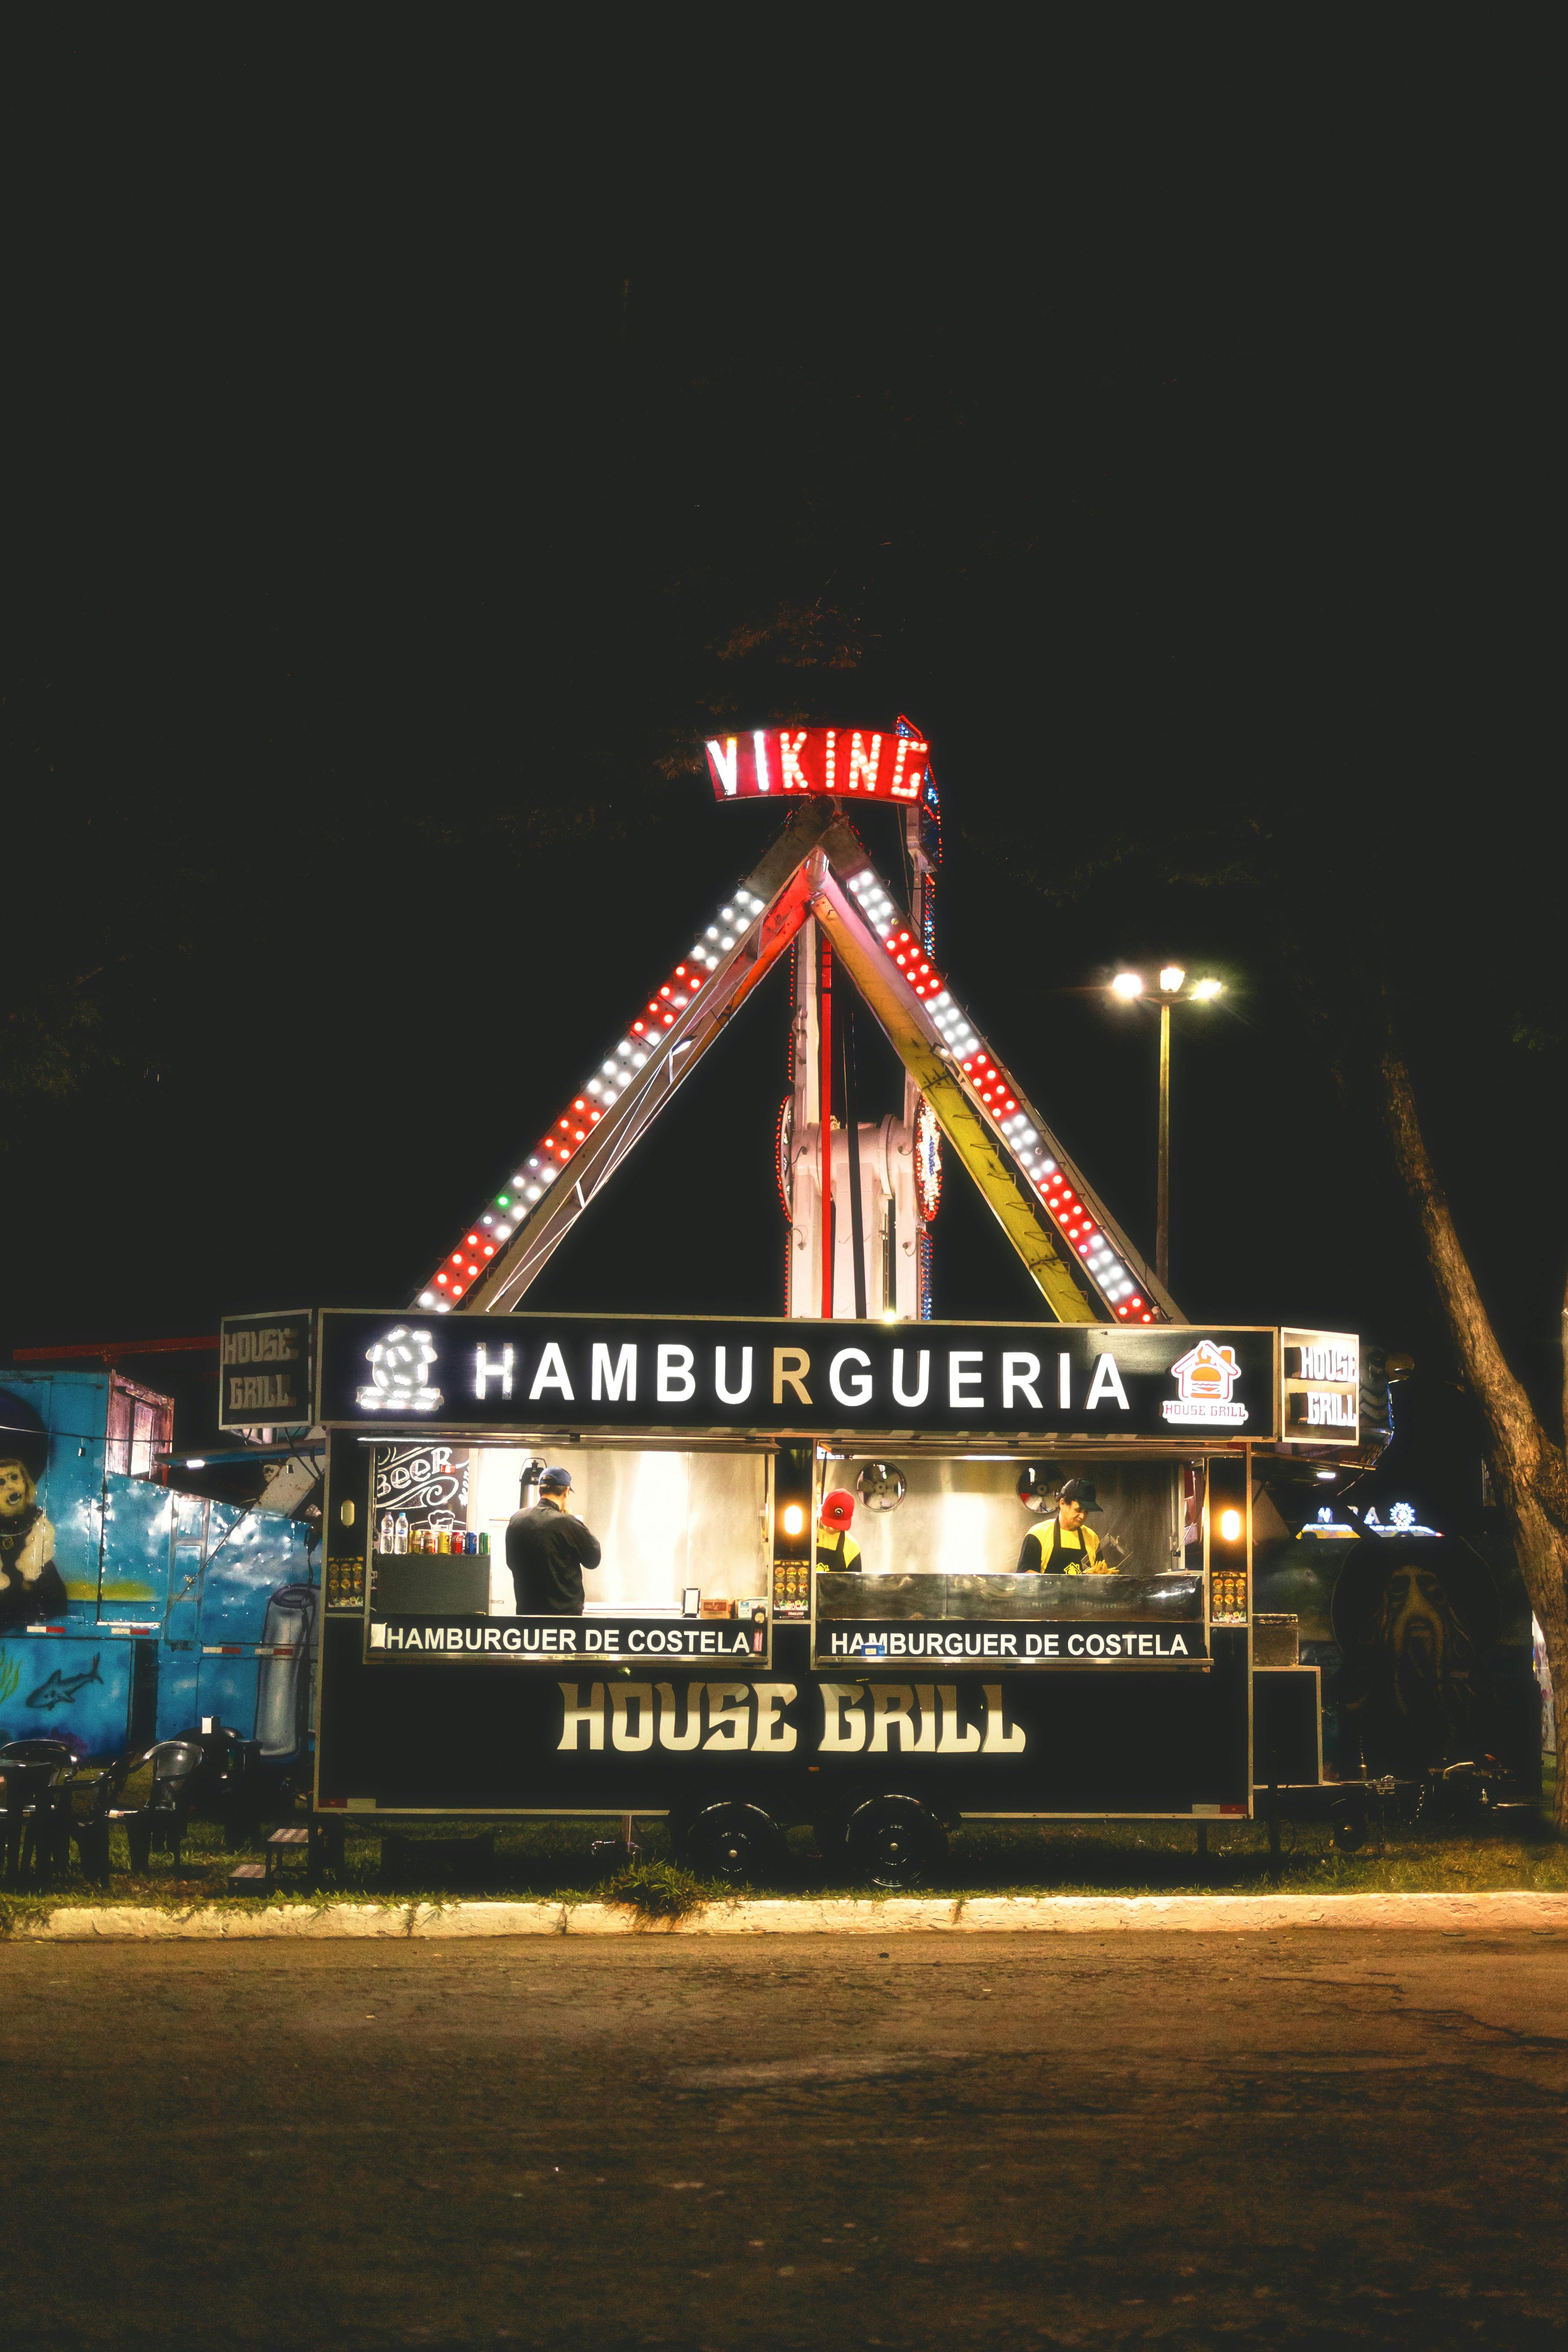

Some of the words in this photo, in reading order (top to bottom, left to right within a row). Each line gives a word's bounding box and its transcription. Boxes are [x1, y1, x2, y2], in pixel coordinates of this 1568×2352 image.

[706, 730, 928, 797] VIKING
[223, 1328, 291, 1365] HOUSE
[1300, 1346, 1358, 1382] HOUSE
[229, 1374, 289, 1409] GRILL
[476, 1342, 1130, 1409] HAMBURGUERIA
[1166, 1404, 1206, 1416] HOUSE
[1210, 1406, 1245, 1417] GRILL
[1307, 1392, 1358, 1427] GRILL
[387, 1628, 576, 1651] HAMBURGUER
[585, 1629, 619, 1652] DE
[628, 1630, 750, 1653] COSTELA
[832, 1633, 1017, 1655] HAMBURGUER
[1026, 1634, 1059, 1656] DE
[1068, 1634, 1188, 1656] COSTELA
[557, 1683, 797, 1752] HOUSE
[817, 1684, 1026, 1753] GRILL
